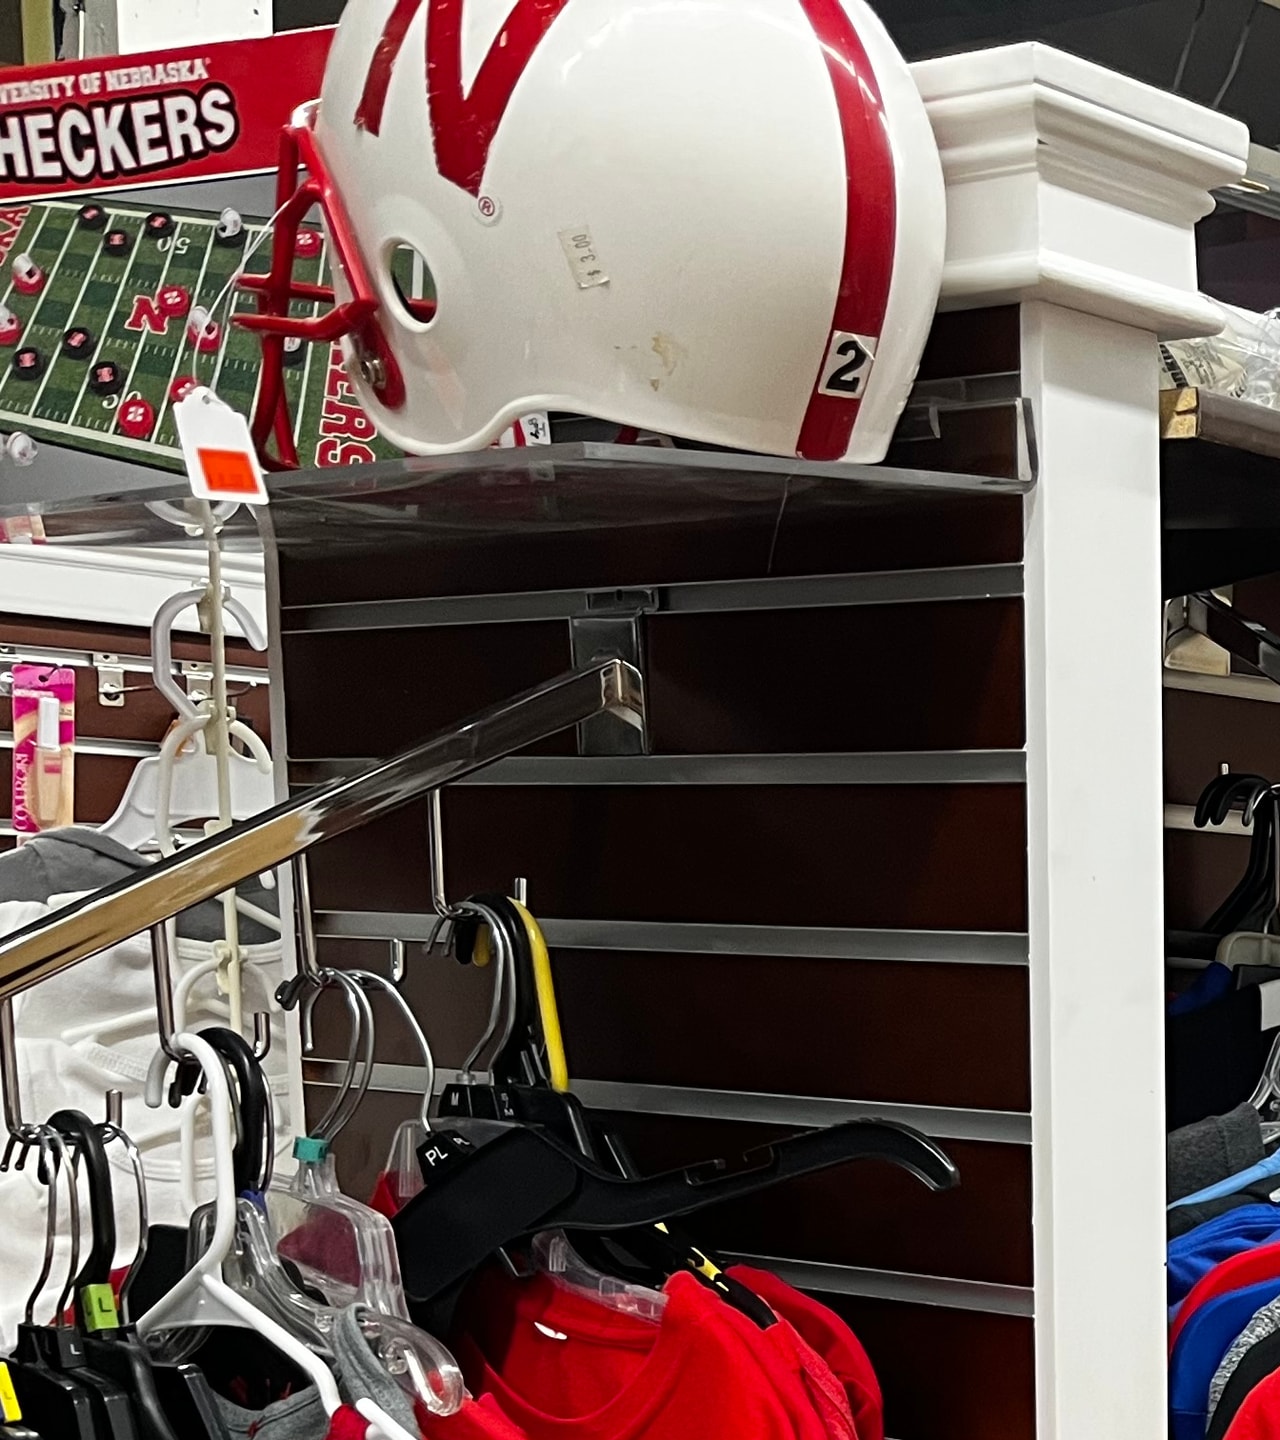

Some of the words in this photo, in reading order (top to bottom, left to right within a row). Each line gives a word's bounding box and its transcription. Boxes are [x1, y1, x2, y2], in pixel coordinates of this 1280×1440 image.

[78, 72, 102, 94] OF
[105, 58, 209, 91] NEBRASKA
[0, 88, 235, 177] HECKERS
[825, 340, 867, 393] 2
[424, 1145, 449, 1167] PL
[98, 1296, 113, 1313] L
[69, 1342, 82, 1356] L
